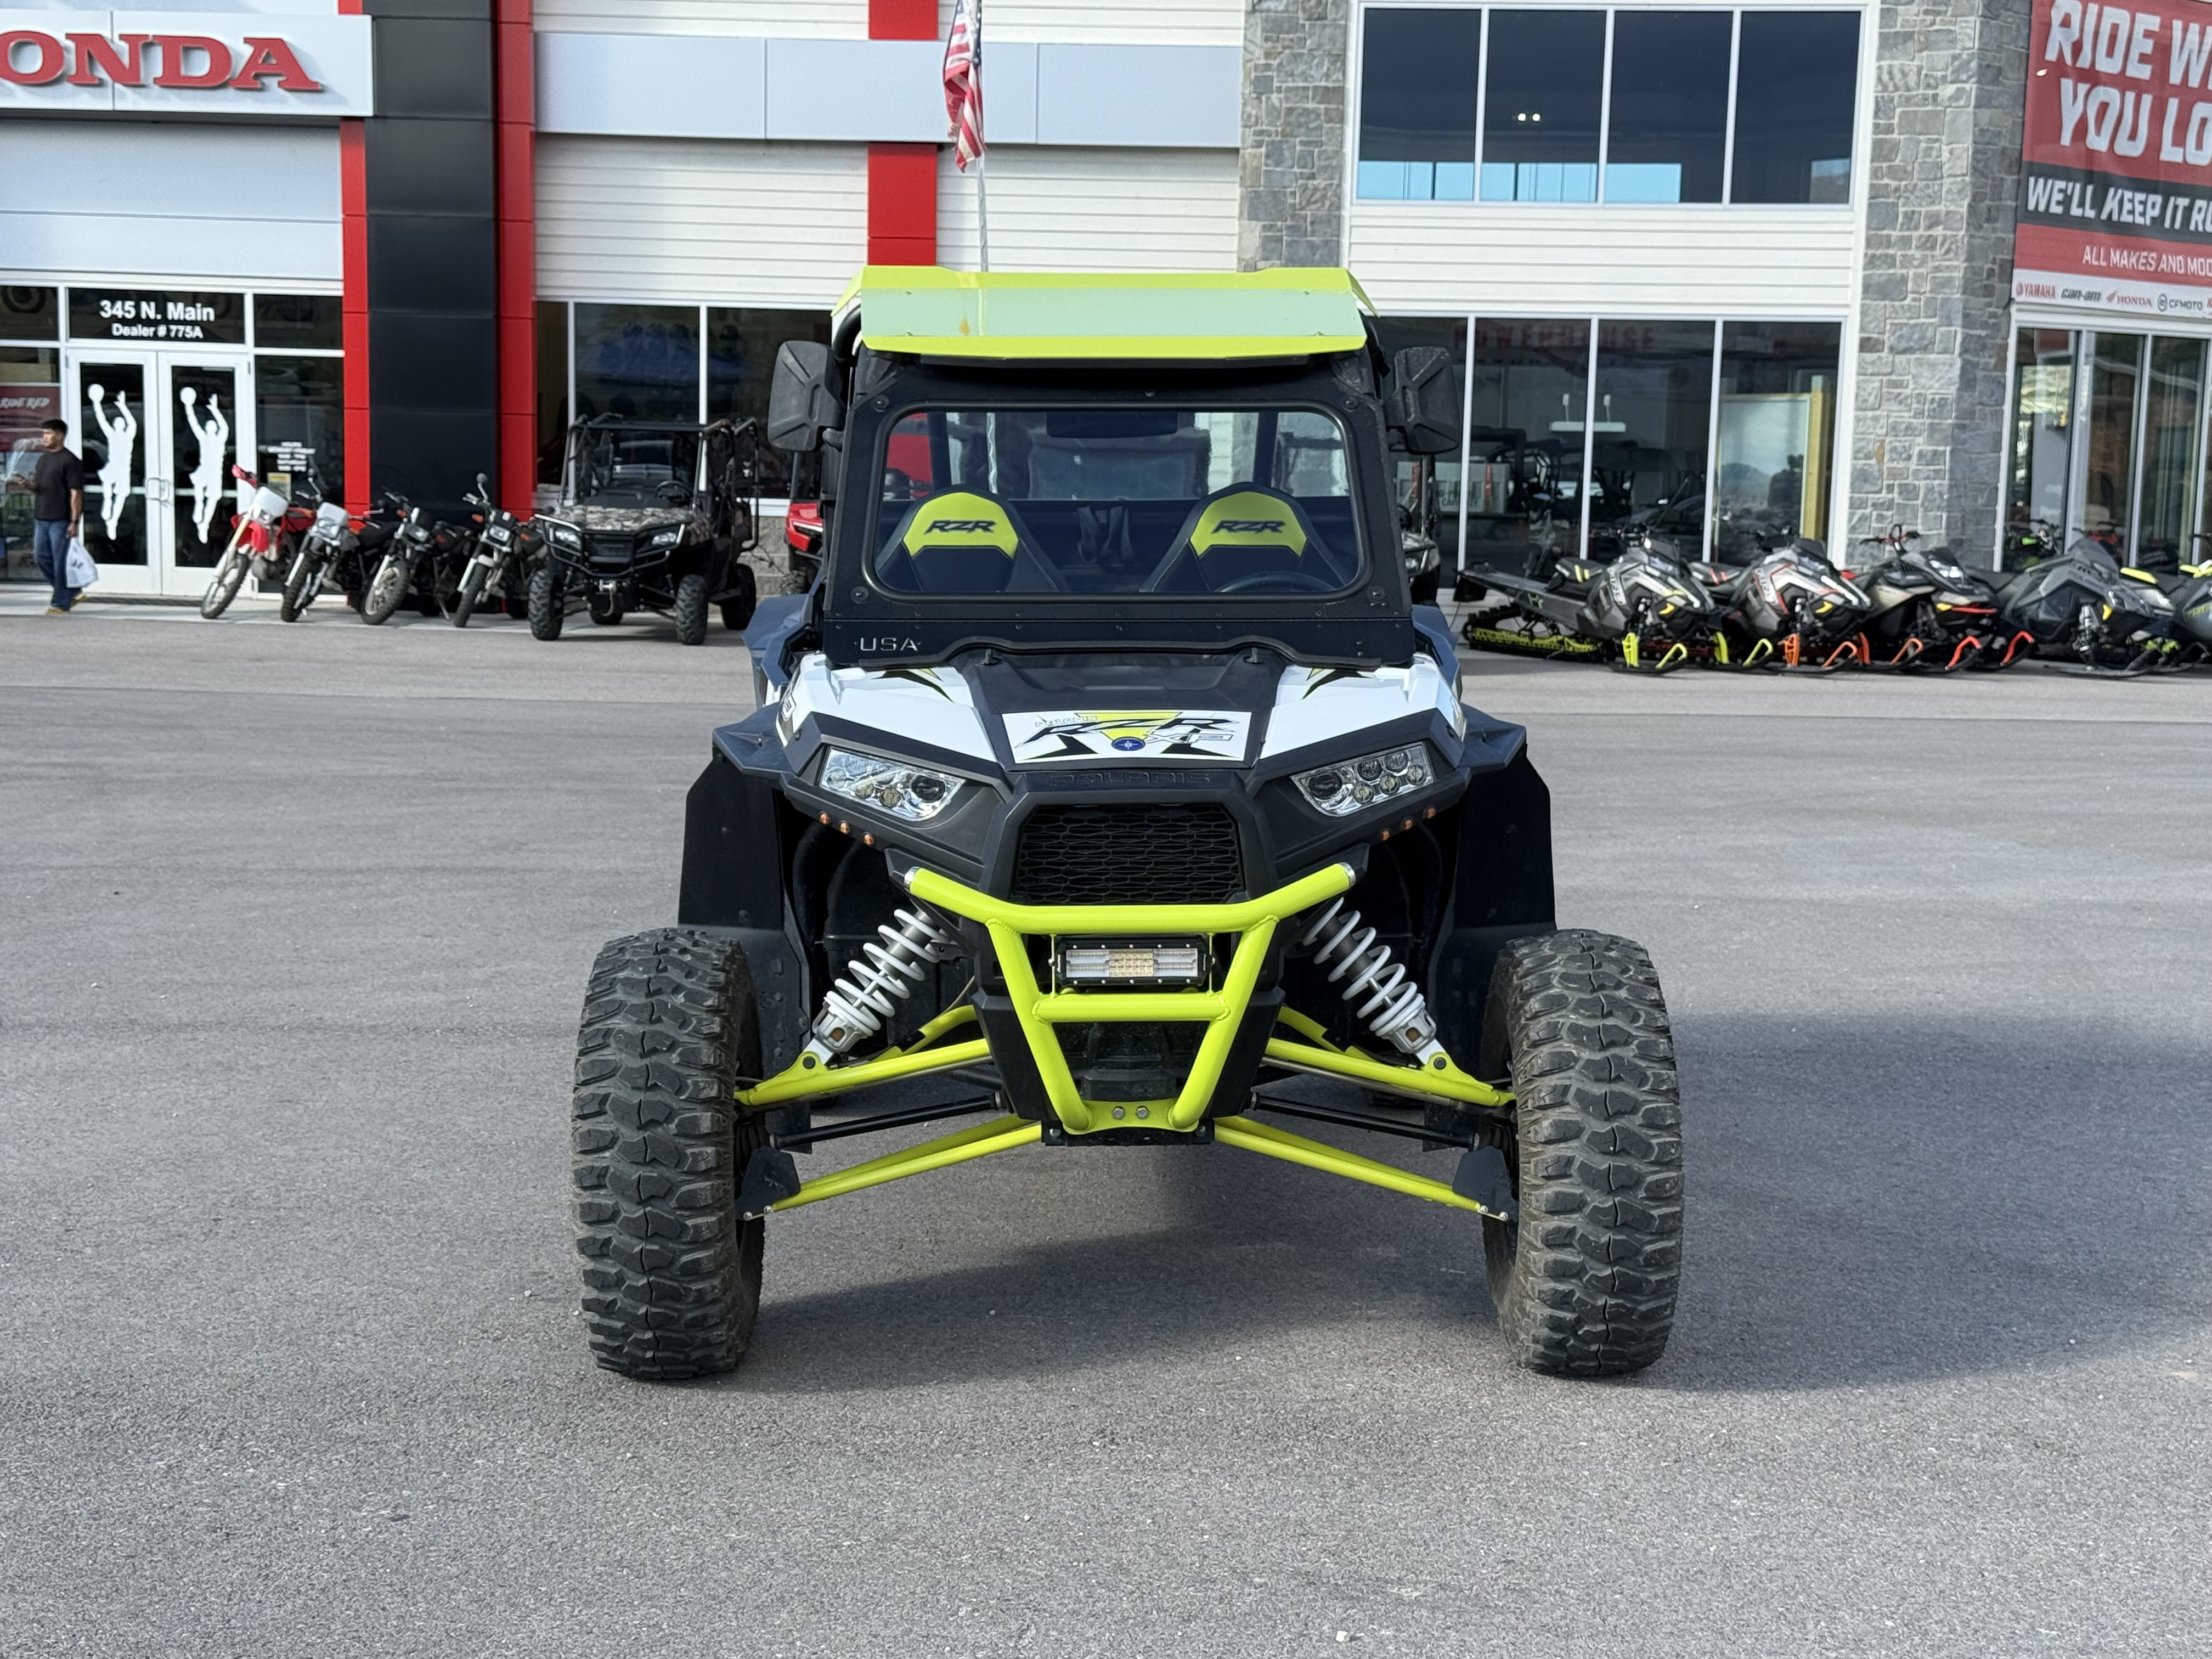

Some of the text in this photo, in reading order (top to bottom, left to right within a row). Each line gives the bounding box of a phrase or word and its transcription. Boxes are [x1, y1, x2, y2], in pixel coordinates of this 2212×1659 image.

[2044, 0, 2212, 92] RIDE W
[0, 30, 320, 91] ONDA
[2059, 77, 2212, 167] YOU LO
[2027, 176, 2097, 219] WE'LL
[2100, 187, 2163, 227] KEEP
[2164, 195, 2191, 230] IT
[2082, 245, 2107, 267] ALL
[2109, 247, 2157, 272] MAKES
[2157, 254, 2185, 274] AND
[2023, 282, 2056, 300] YAMAHA
[2116, 295, 2153, 307] HONDA
[99, 299, 216, 321] 345 N. Main
[111, 323, 204, 339] Dealer # 775A
[923, 520, 996, 535] RZR
[1211, 520, 1286, 535] RZR
[860, 637, 918, 651] USA
[1014, 717, 1240, 748] RZR
[1143, 732, 1234, 744] XP
[1048, 771, 1211, 787] POLARIS
